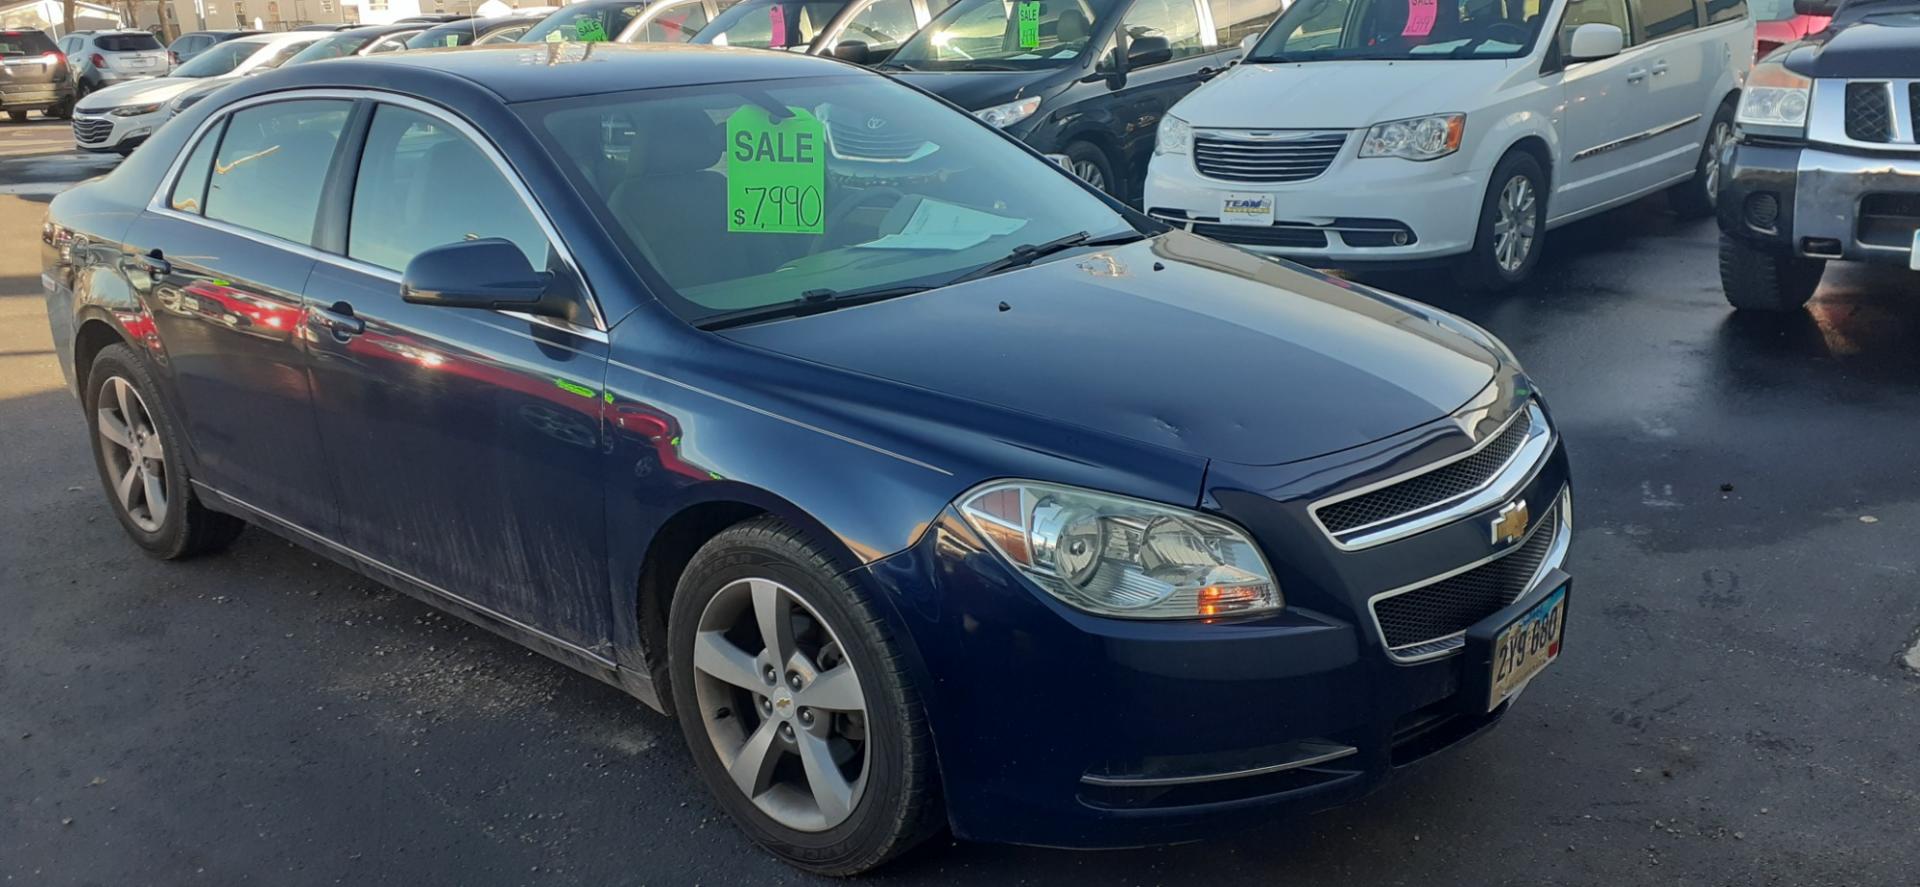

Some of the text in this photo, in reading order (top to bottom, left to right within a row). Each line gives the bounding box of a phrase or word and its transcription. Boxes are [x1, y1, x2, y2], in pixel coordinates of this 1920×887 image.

[1020, 10, 1037, 21] SALE
[578, 21, 600, 36] SALE
[735, 131, 814, 164] SALE
[1224, 199, 1263, 209] TEAM
